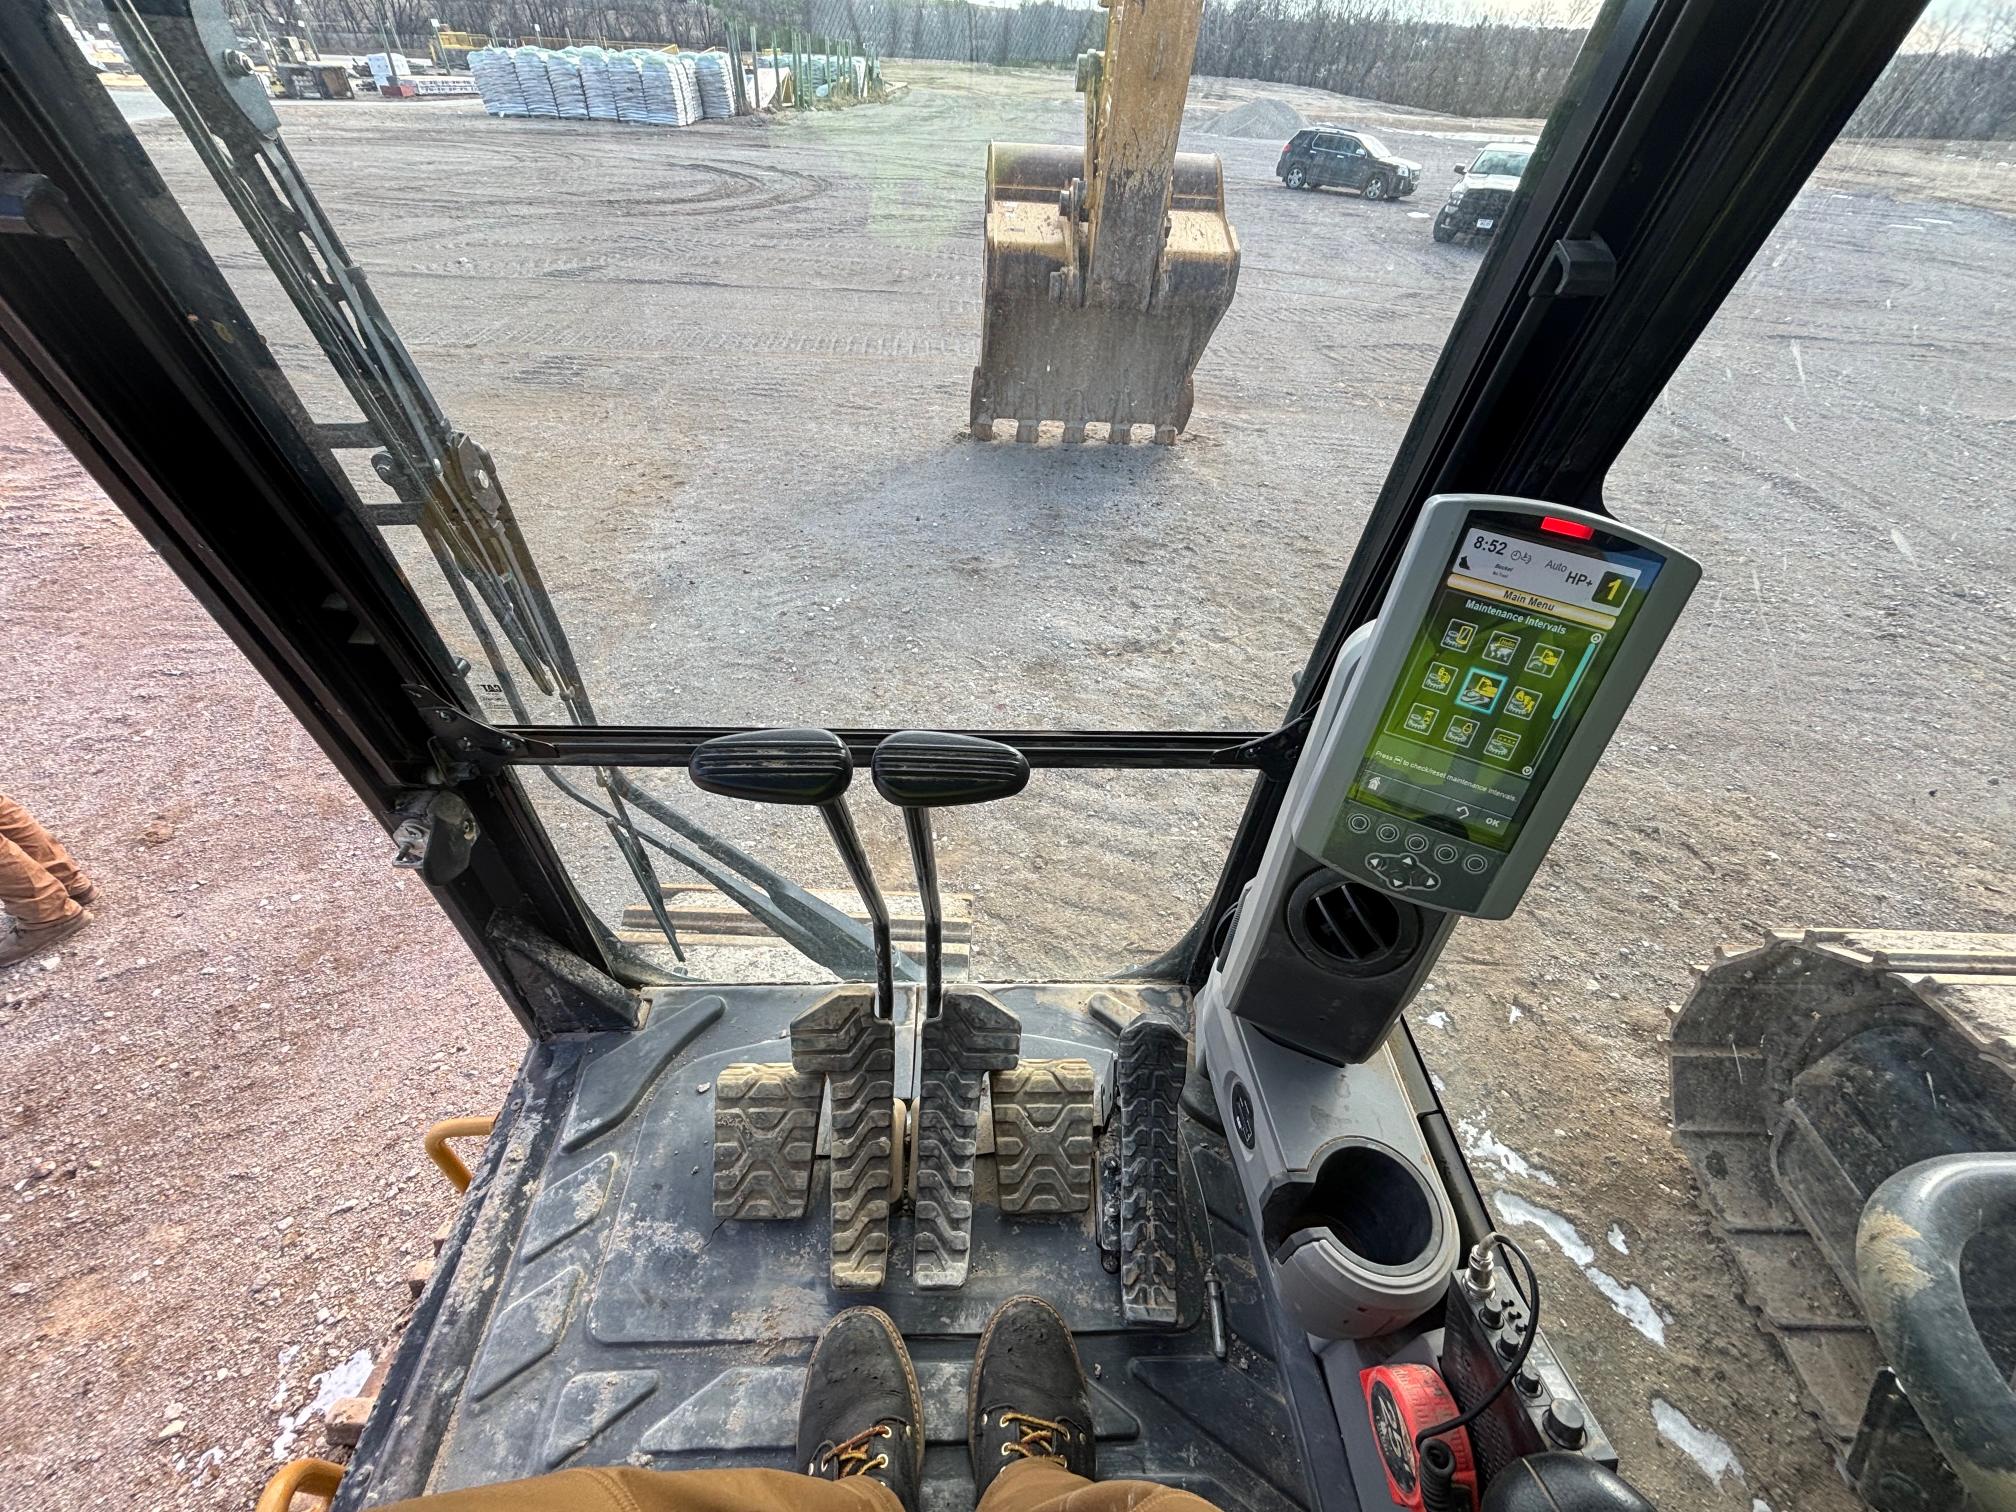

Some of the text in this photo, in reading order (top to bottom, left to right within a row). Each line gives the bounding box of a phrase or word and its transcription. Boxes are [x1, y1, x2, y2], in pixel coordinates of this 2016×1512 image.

[1473, 535, 1508, 556] 8:52
[1544, 559, 1568, 573] Auto
[1564, 571, 1593, 588] HP+
[1607, 578, 1623, 601] 1
[1503, 589, 1556, 612] Main Menu
[1465, 598, 1568, 636] Maintenance Intervals
[1375, 750, 1393, 762] Press
[1402, 759, 1410, 767] to
[1446, 774, 1488, 793] maintenance
[1485, 817, 1500, 828] OK
